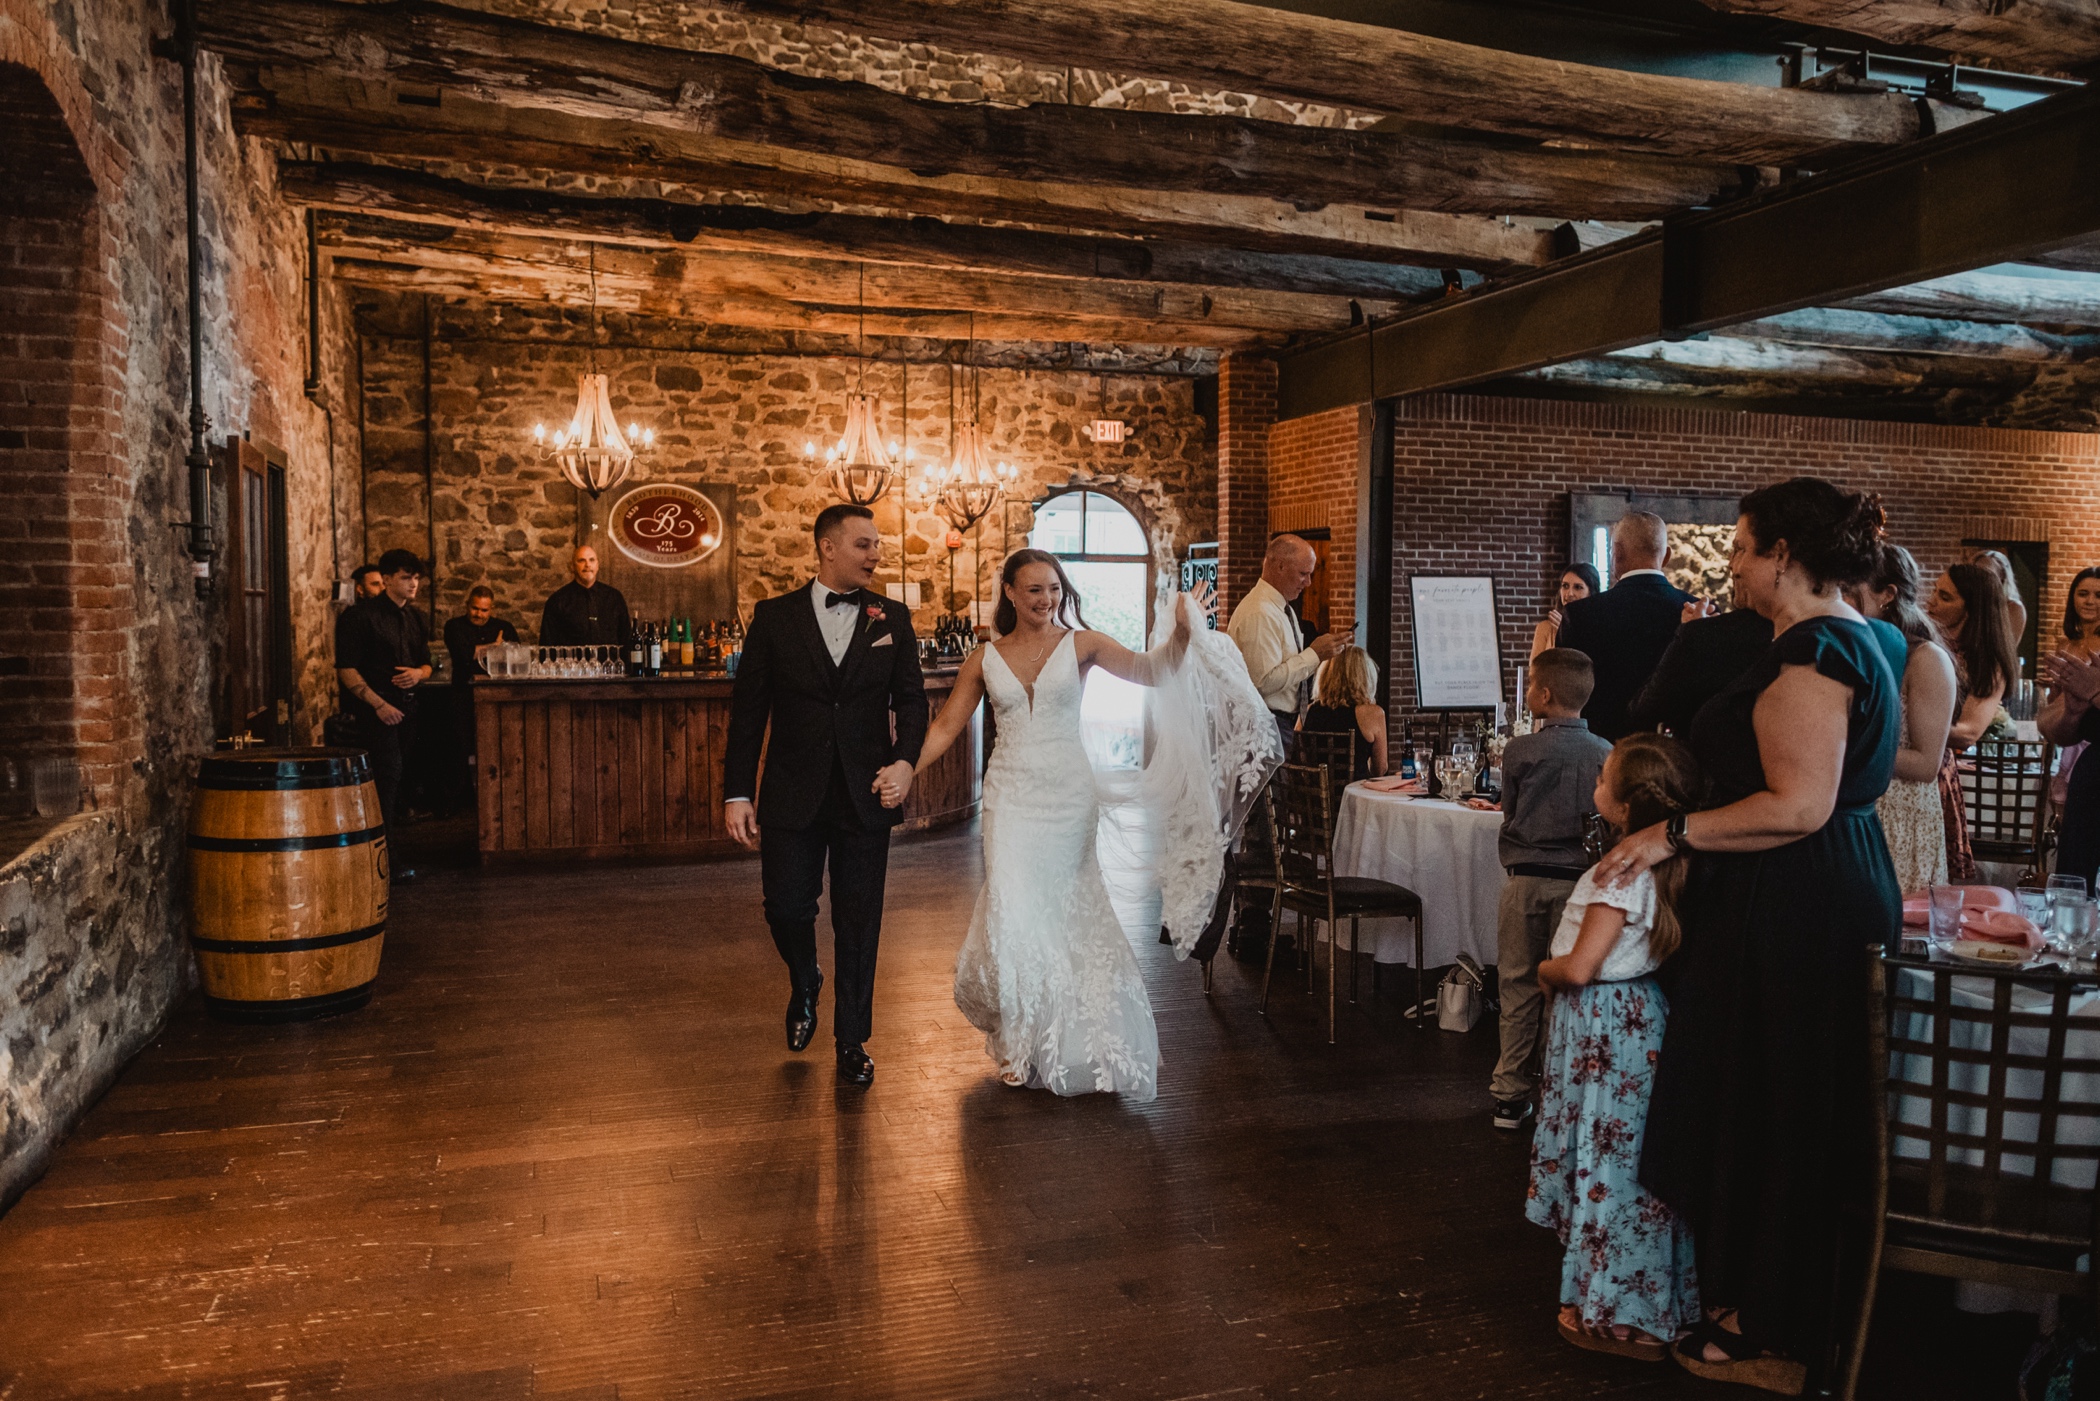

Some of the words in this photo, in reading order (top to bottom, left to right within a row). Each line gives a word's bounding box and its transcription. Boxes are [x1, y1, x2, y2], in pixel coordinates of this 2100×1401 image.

[1097, 421, 1120, 440] EXIT
[625, 488, 708, 510] BROTHERHOOD
[692, 508, 706, 522] 2014
